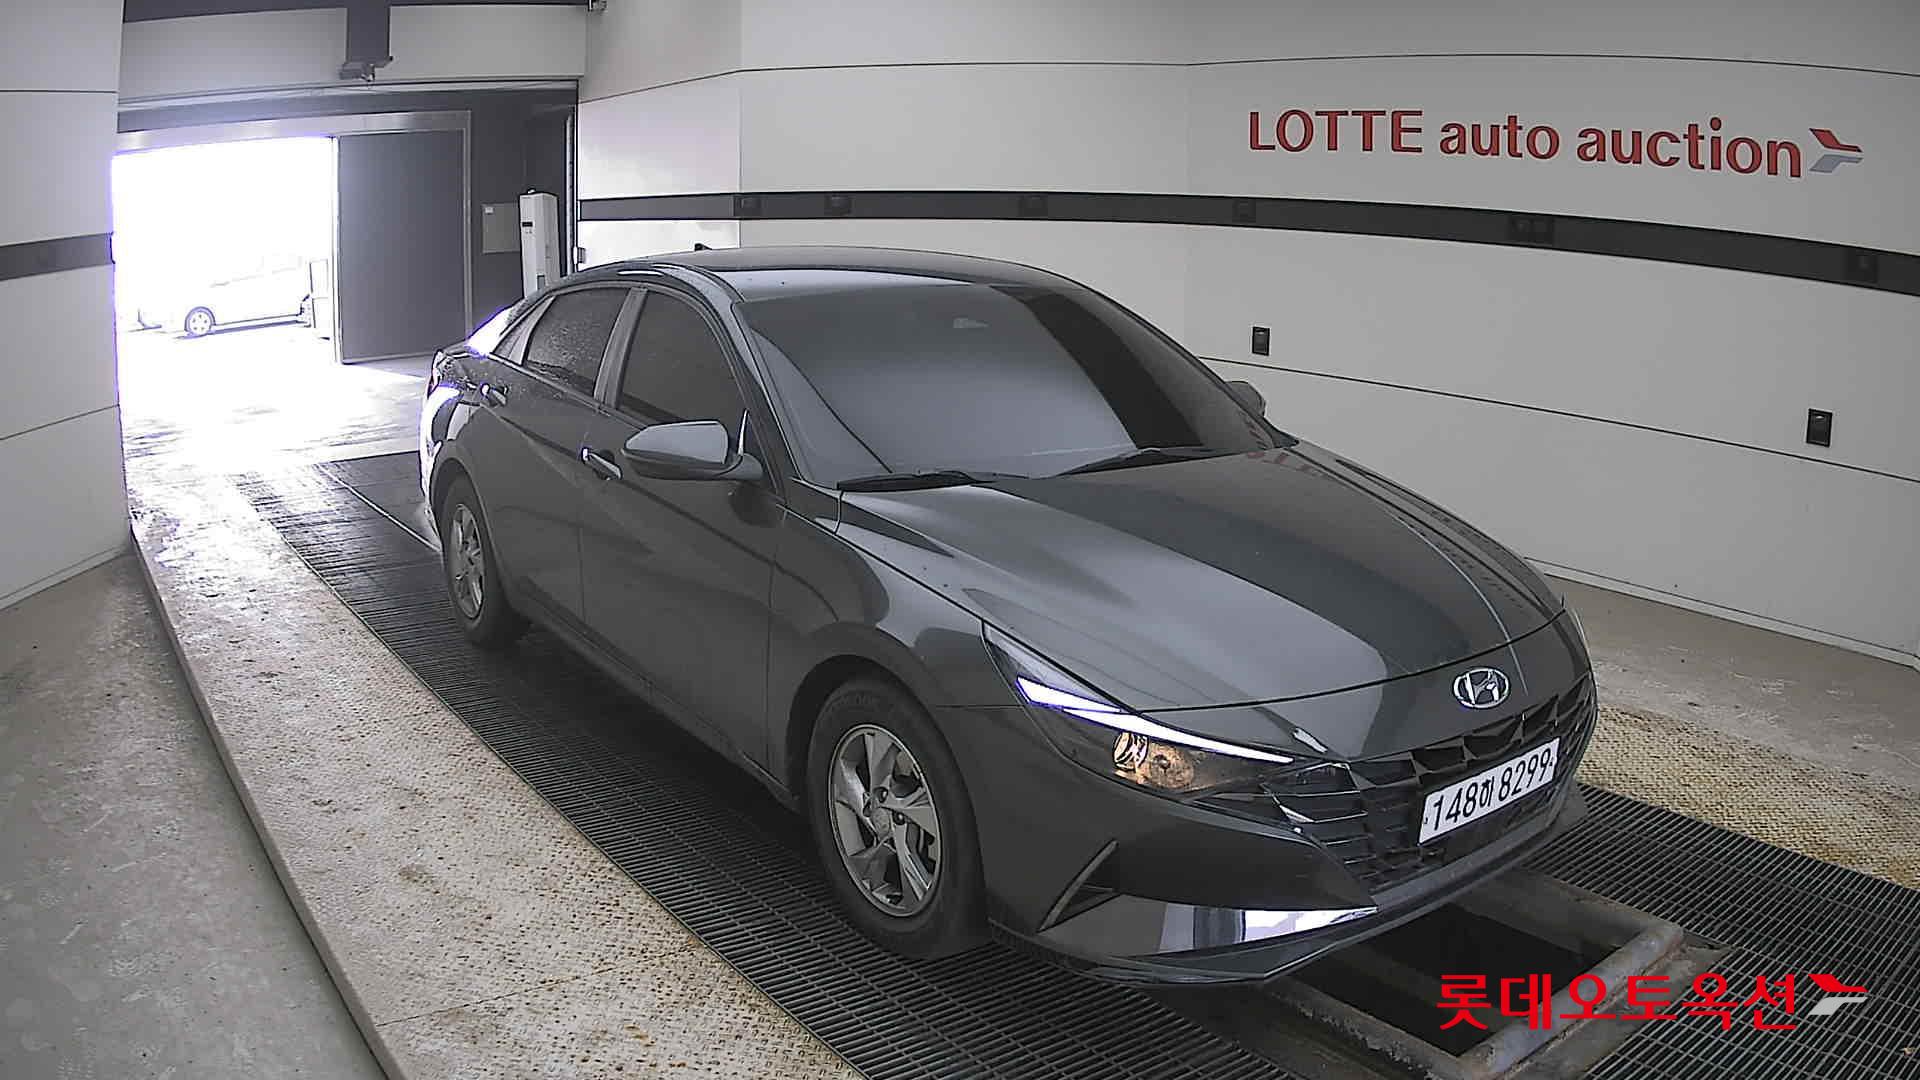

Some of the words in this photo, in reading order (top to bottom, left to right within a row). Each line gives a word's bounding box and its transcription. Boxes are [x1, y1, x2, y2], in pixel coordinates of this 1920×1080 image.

[1249, 109, 1424, 154] LOTTE
[1440, 116, 1561, 159] auto
[1577, 117, 1802, 178] auction
[1498, 747, 1552, 802] 8299
